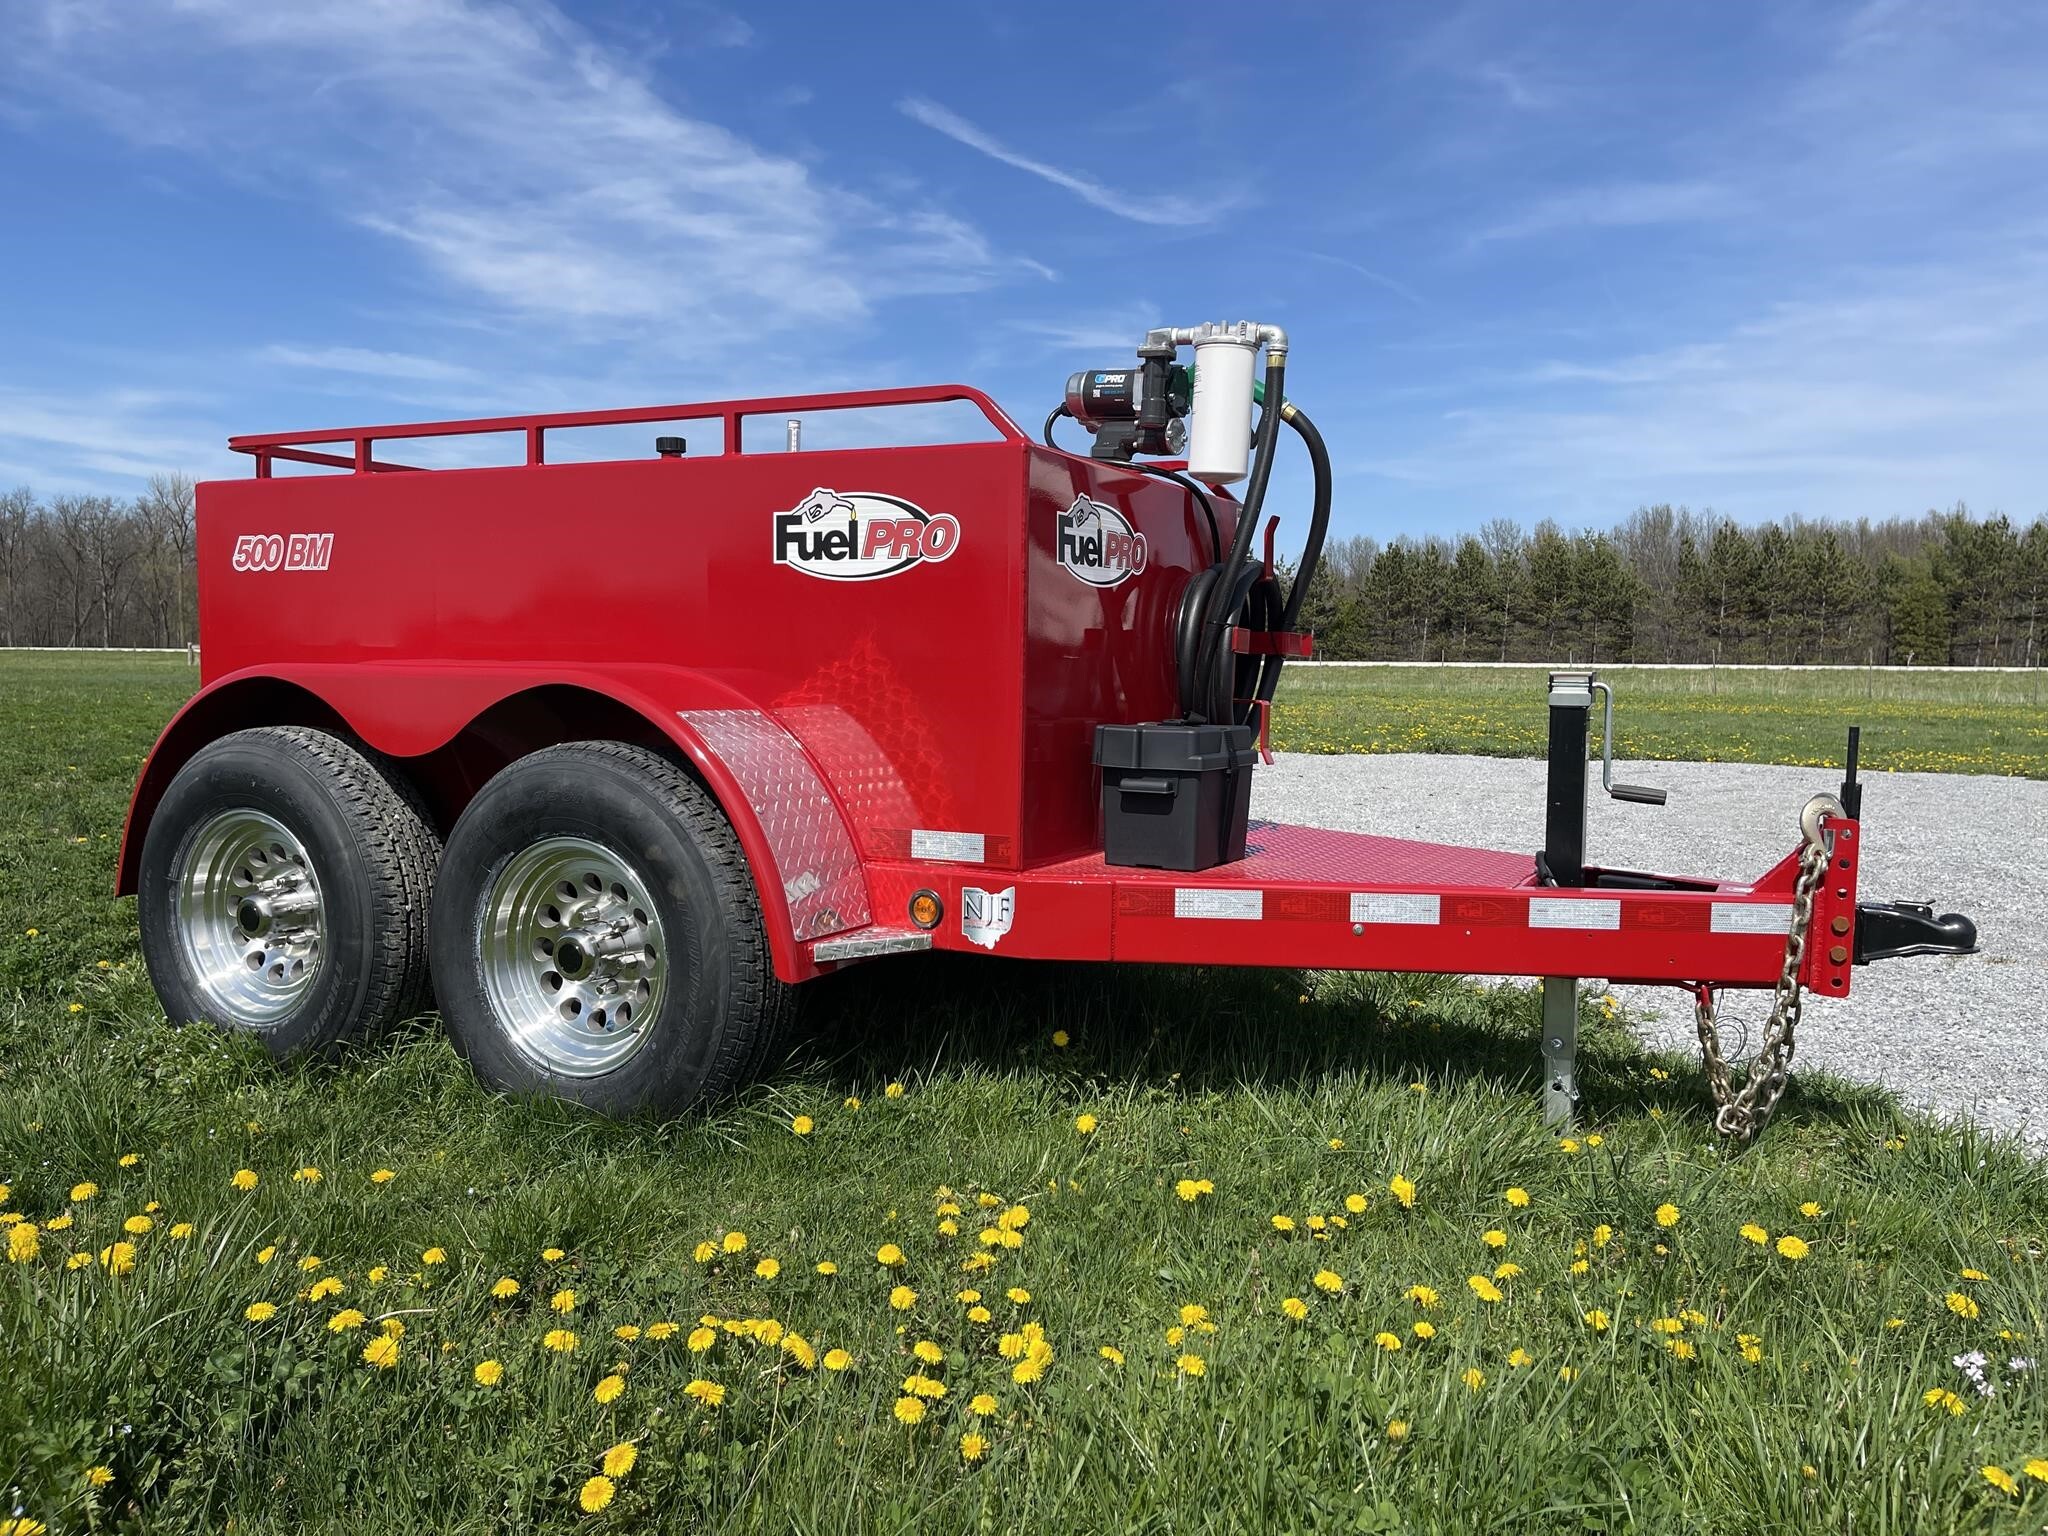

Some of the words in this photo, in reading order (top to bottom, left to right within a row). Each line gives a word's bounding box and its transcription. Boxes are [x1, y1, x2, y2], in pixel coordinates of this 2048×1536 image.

[233, 535, 284, 571] 500
[285, 534, 334, 571] BM
[776, 515, 858, 561] Fuel
[861, 516, 957, 560] PRO
[1058, 515, 1103, 567] Fuel
[1104, 531, 1147, 572] PRO
[964, 894, 1010, 927] NJF
